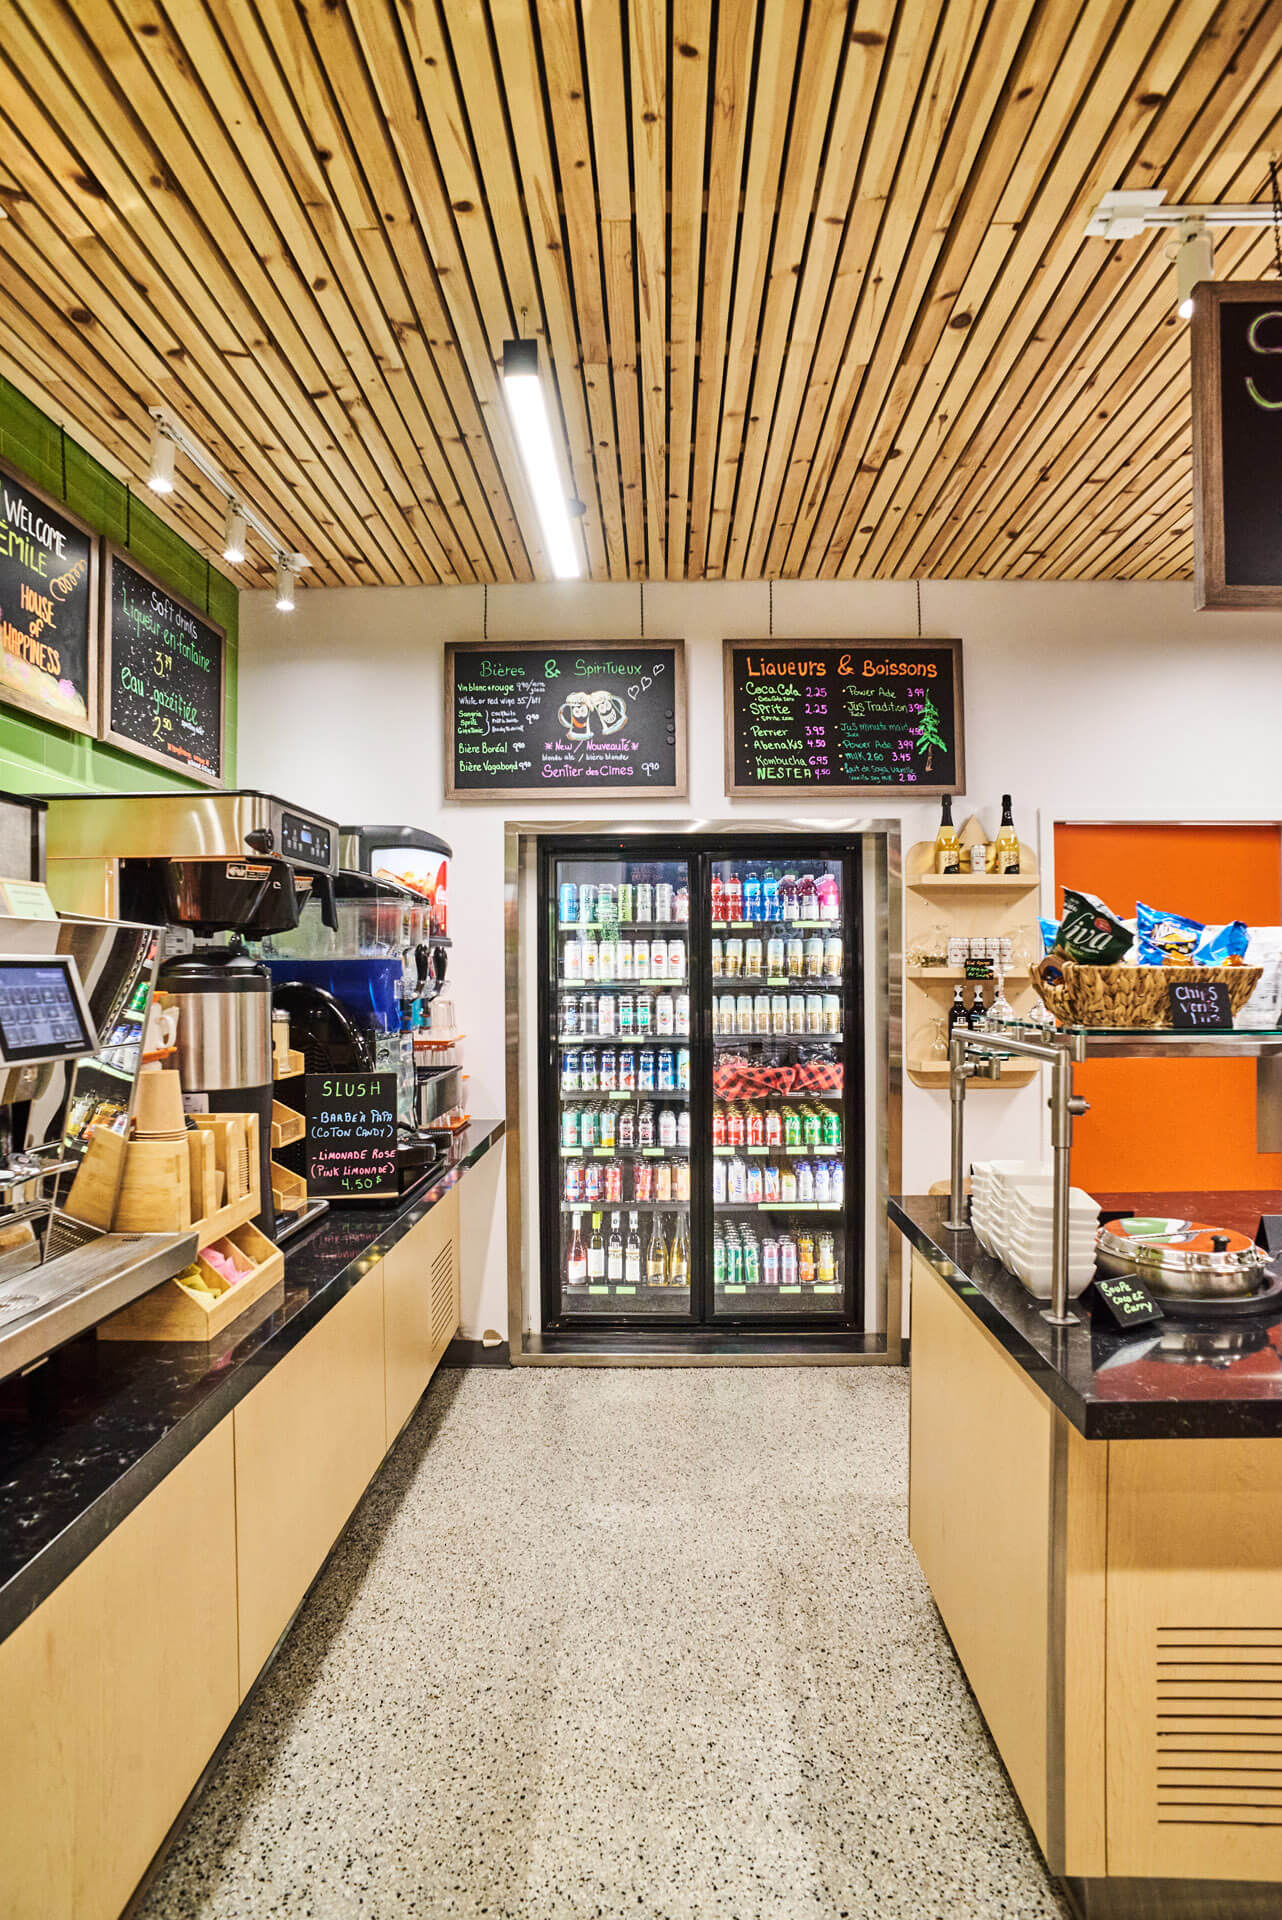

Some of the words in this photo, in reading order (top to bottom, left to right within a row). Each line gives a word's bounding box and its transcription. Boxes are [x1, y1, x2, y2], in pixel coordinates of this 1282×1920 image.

[4, 489, 67, 560] WELCOME
[21, 583, 56, 629] HOUSE
[121, 587, 160, 638] Liqueur
[164, 629, 176, 649] en
[151, 591, 174, 623] Soft
[176, 609, 198, 640] drinks
[2, 620, 61, 675] HAPPINESS
[480, 660, 526, 677] Bières
[544, 659, 561, 678] &
[746, 657, 827, 677] Liqueurs
[837, 654, 855, 676] &
[862, 659, 938, 678] Boissons
[469, 683, 487, 692] blanc
[492, 684, 514, 695] rouge
[746, 682, 776, 696] Coca
[777, 683, 802, 696] Cola
[806, 687, 828, 697] 2.25
[846, 685, 876, 696] Power
[878, 687, 896, 698] Ade
[804, 704, 828, 714] 2.25
[848, 701, 866, 712] Jus
[864, 700, 908, 712] Tradition
[750, 726, 788, 736] Perrier
[804, 726, 825, 736] 3.95
[840, 722, 858, 731] Jus
[459, 742, 480, 754] Bière
[482, 742, 508, 754] Boréal
[556, 739, 573, 751] New
[807, 739, 826, 748] 4.50
[842, 740, 870, 749] Power
[756, 755, 808, 766] Kombucha
[808, 756, 828, 766] 6.95
[892, 752, 912, 762] 3.45
[460, 760, 482, 772] Bière
[483, 760, 518, 775] Vagabond
[586, 767, 599, 776] des
[600, 766, 634, 776] Cimes
[756, 767, 812, 780] NESTEA
[814, 768, 830, 780] 4.50
[322, 1081, 380, 1097] SLUSH
[320, 1112, 358, 1123] BARBE
[370, 1109, 393, 1122] PAPA
